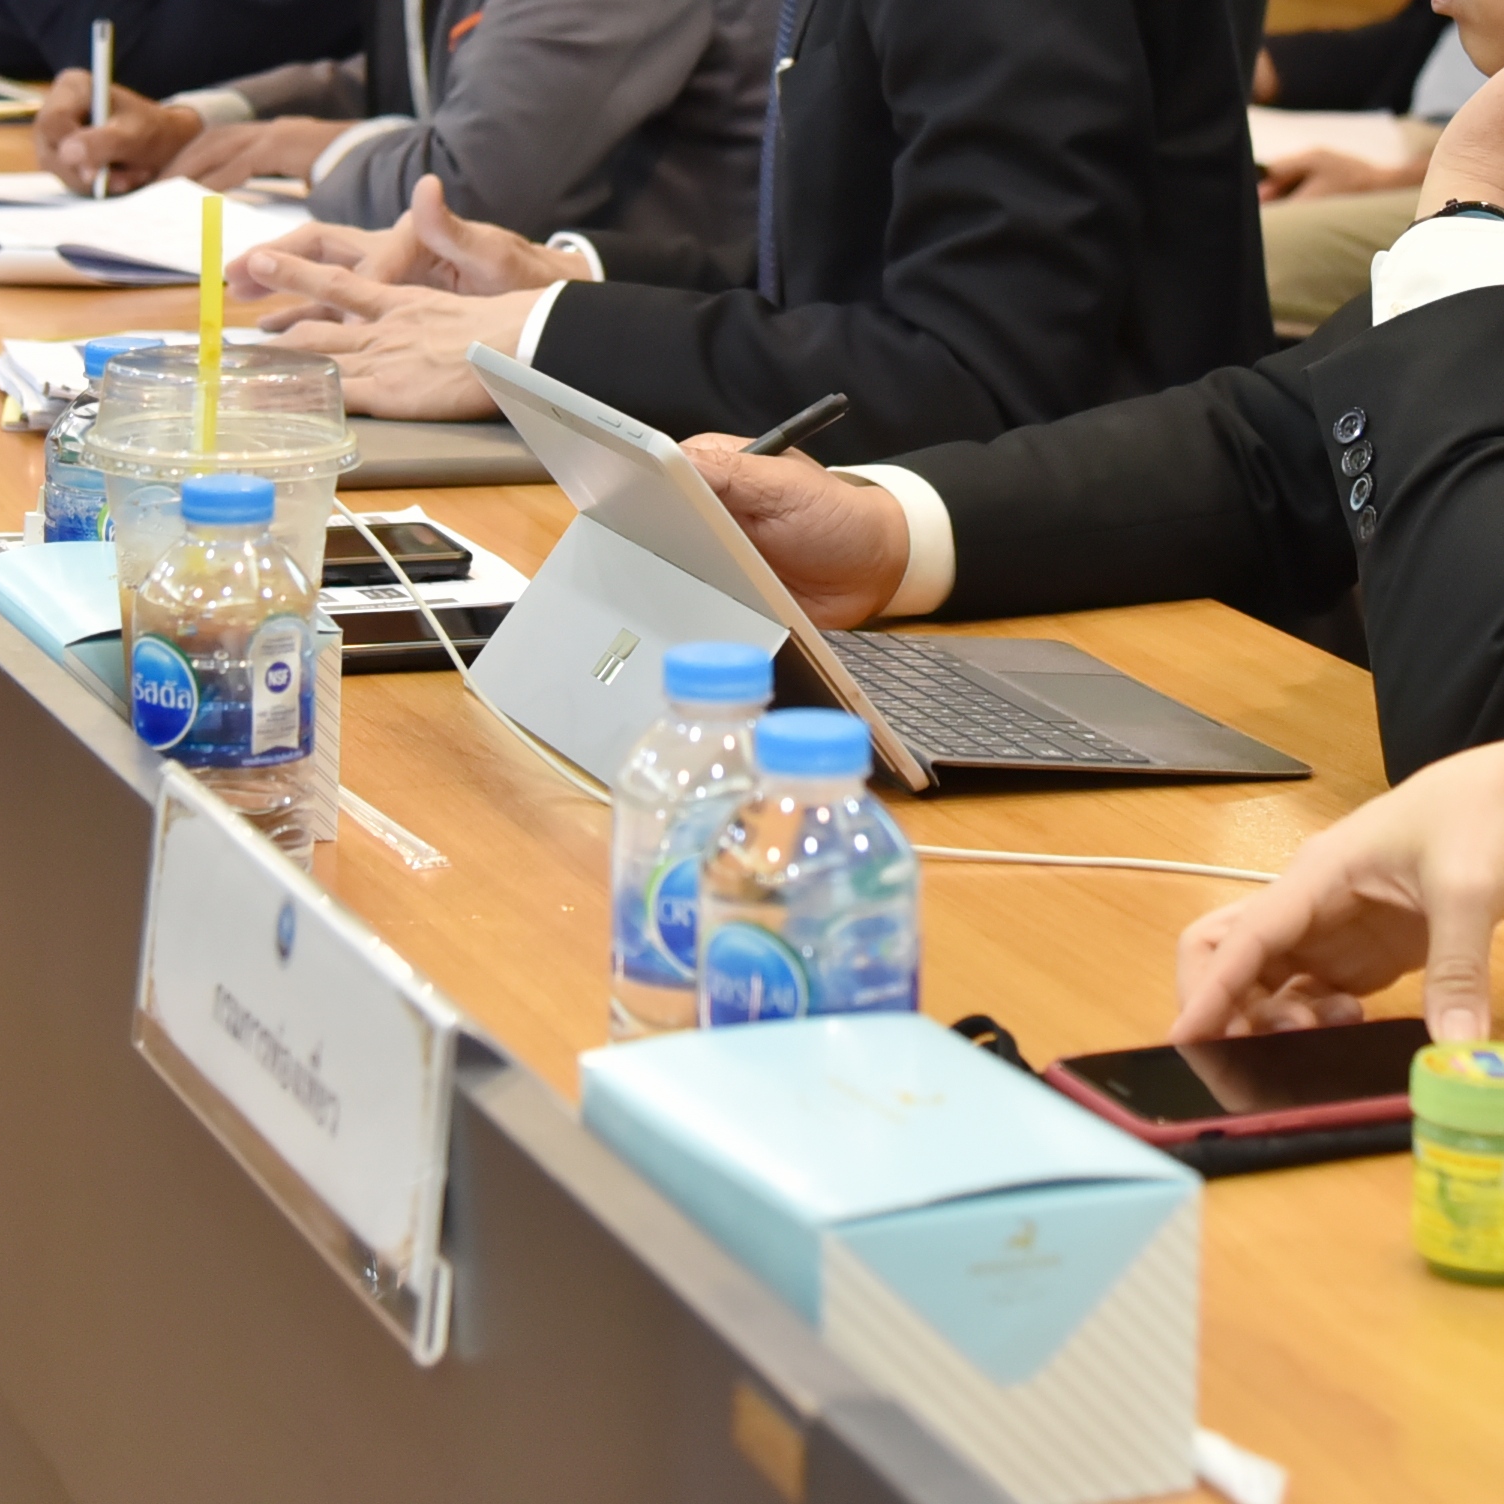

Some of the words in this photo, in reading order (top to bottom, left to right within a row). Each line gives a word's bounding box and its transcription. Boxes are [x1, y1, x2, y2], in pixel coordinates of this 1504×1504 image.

[132, 672, 192, 709] ริสตัล
[267, 668, 289, 686] NSF
